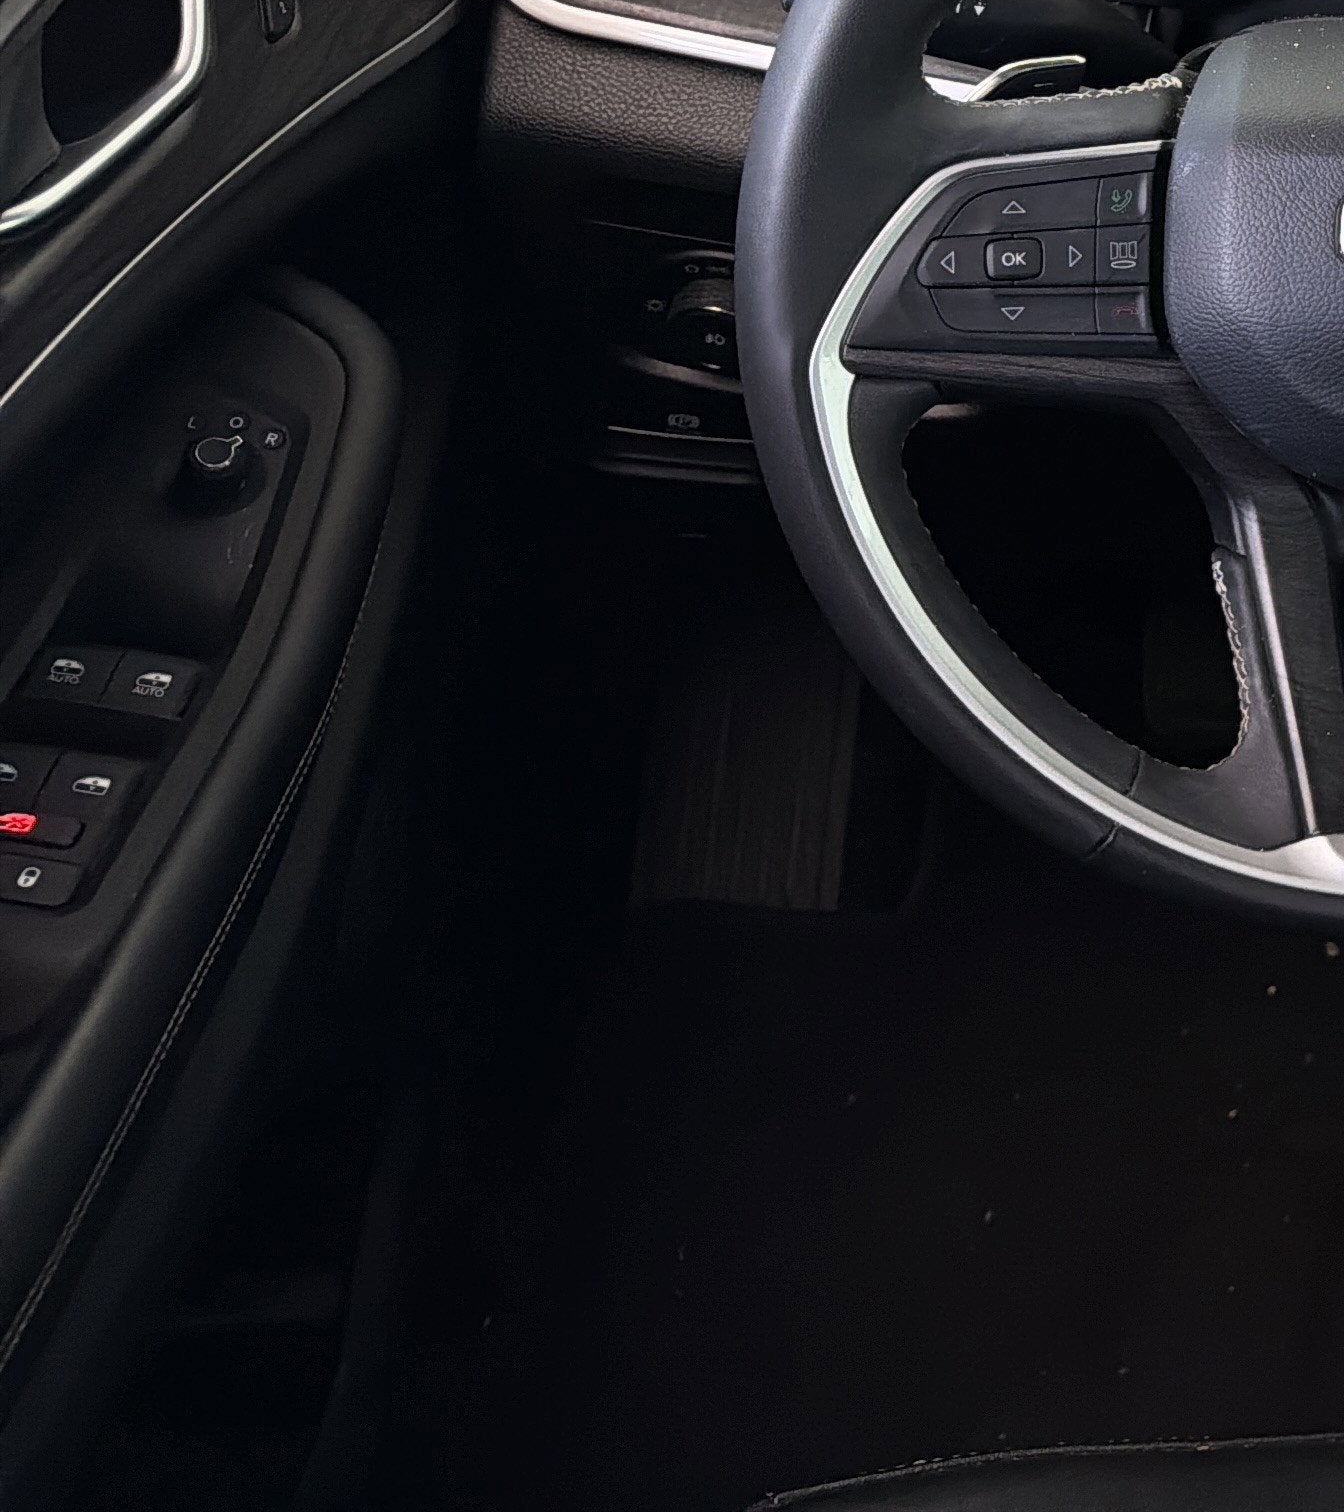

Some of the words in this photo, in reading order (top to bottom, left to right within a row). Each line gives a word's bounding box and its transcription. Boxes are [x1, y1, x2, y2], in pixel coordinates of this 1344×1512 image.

[1001, 251, 1028, 267] OK
[265, 432, 278, 447] R
[48, 674, 81, 685] AUTO
[132, 687, 165, 698] AUTO
